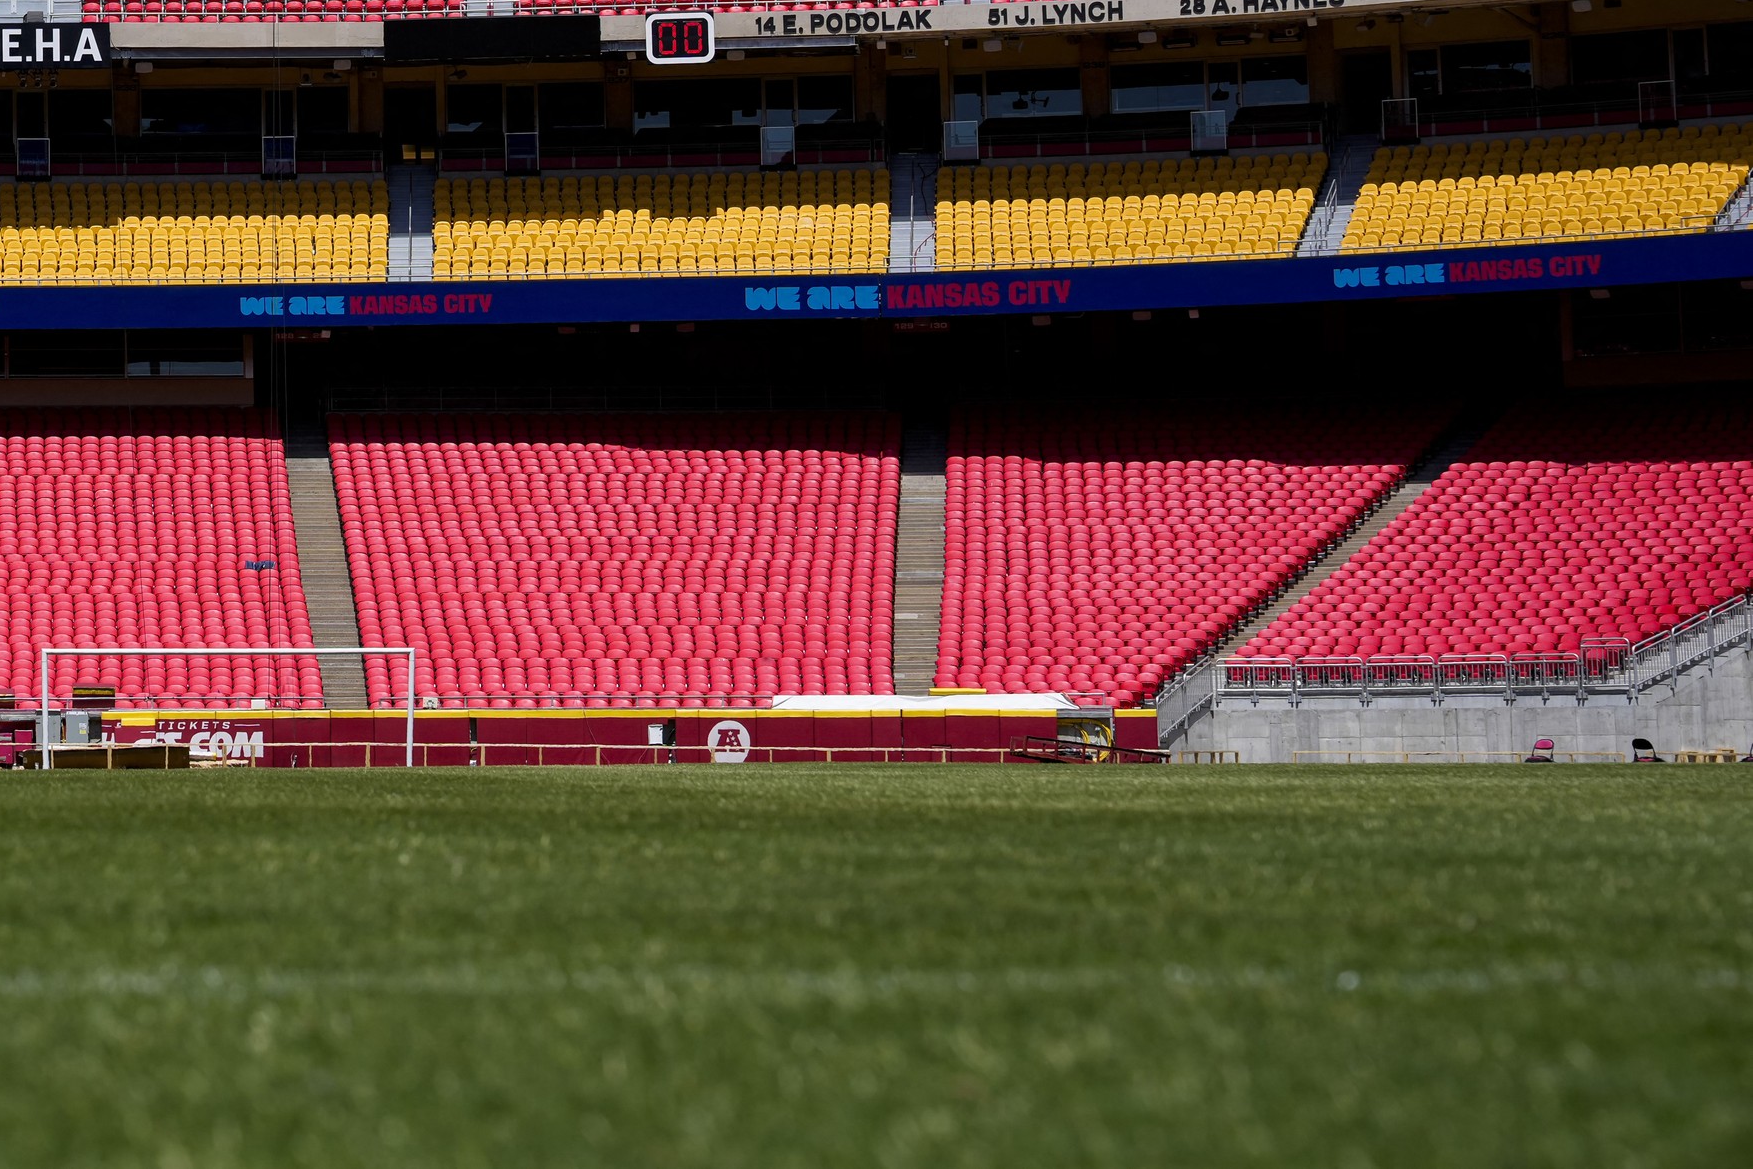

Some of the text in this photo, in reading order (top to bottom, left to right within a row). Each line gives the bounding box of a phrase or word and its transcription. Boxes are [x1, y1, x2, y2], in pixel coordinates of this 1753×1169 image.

[755, 9, 933, 35] 14 E. PODOLAK
[988, 0, 1124, 26] 51 J. LYNCH
[658, 21, 703, 56] 00
[1333, 266, 1380, 288] WE
[1449, 257, 1544, 282] KANSAS
[1549, 254, 1602, 277] CITY
[240, 296, 284, 316] WE
[349, 294, 438, 315] KANSAS
[443, 293, 493, 314] CITY
[745, 286, 801, 311] WE
[886, 281, 999, 309] KANSAS
[1008, 279, 1071, 305] CITY
[158, 721, 232, 730] TICKETS
